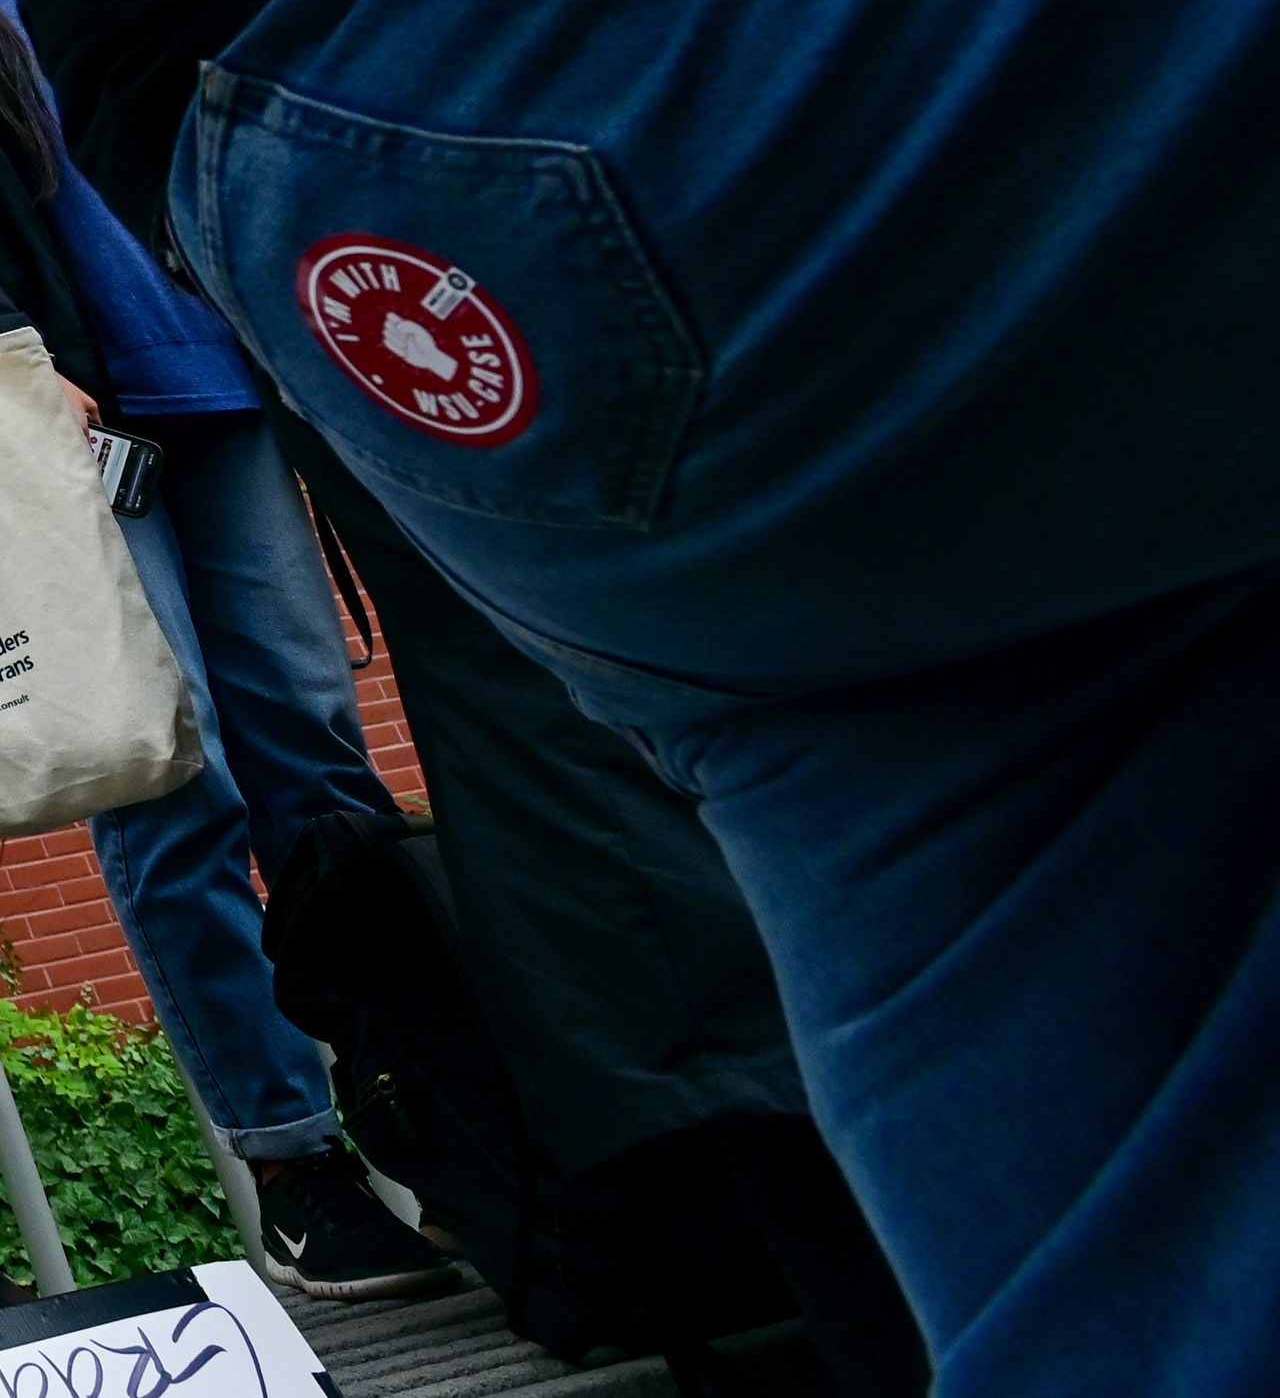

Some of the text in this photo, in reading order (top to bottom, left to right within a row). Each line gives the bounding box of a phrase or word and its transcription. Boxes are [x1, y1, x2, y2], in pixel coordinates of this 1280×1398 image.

[323, 262, 402, 343] I'M WITH
[413, 333, 505, 422] WSU-CASE
